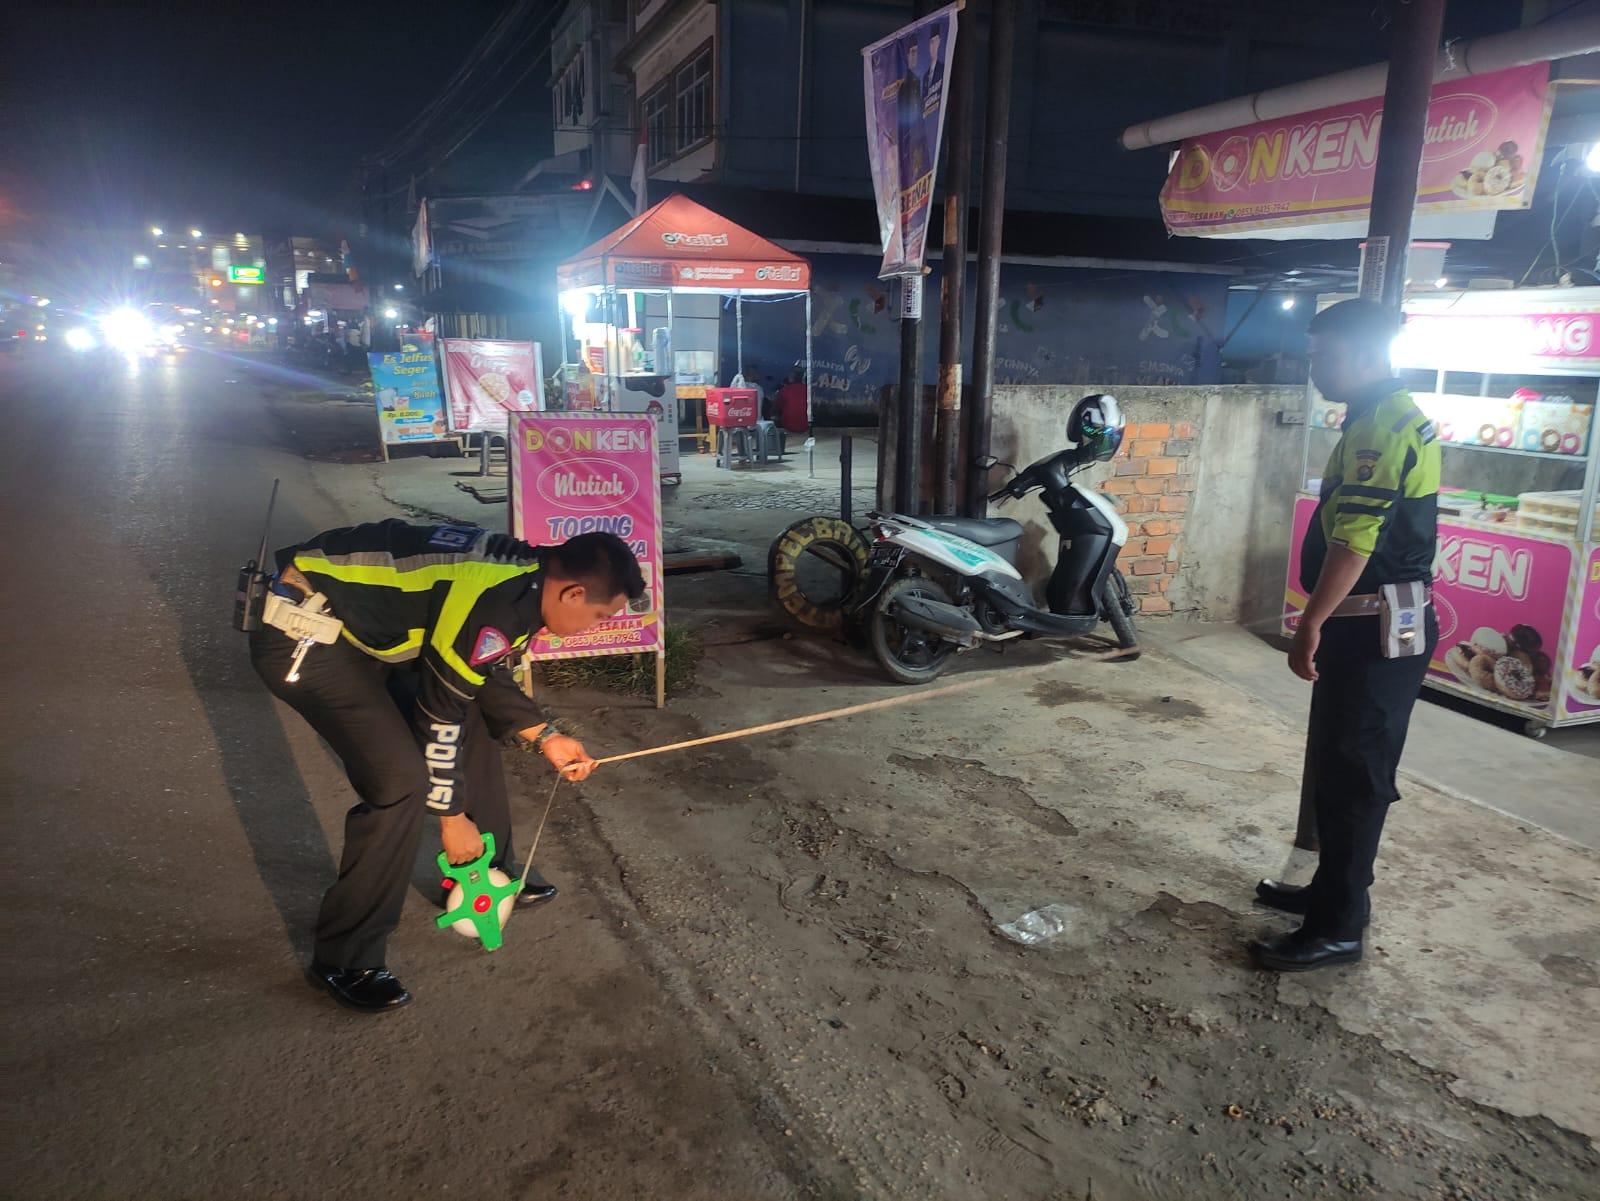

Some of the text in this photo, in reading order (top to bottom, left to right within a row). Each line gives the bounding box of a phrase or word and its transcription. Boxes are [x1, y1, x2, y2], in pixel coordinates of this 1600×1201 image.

[1424, 108, 1479, 145] utiah
[1178, 112, 1383, 190] DONKEN
[525, 428, 647, 453] DONKEN
[554, 472, 625, 498] Mutiah
[547, 514, 633, 541] TOPING
[425, 722, 461, 811] POLISI
